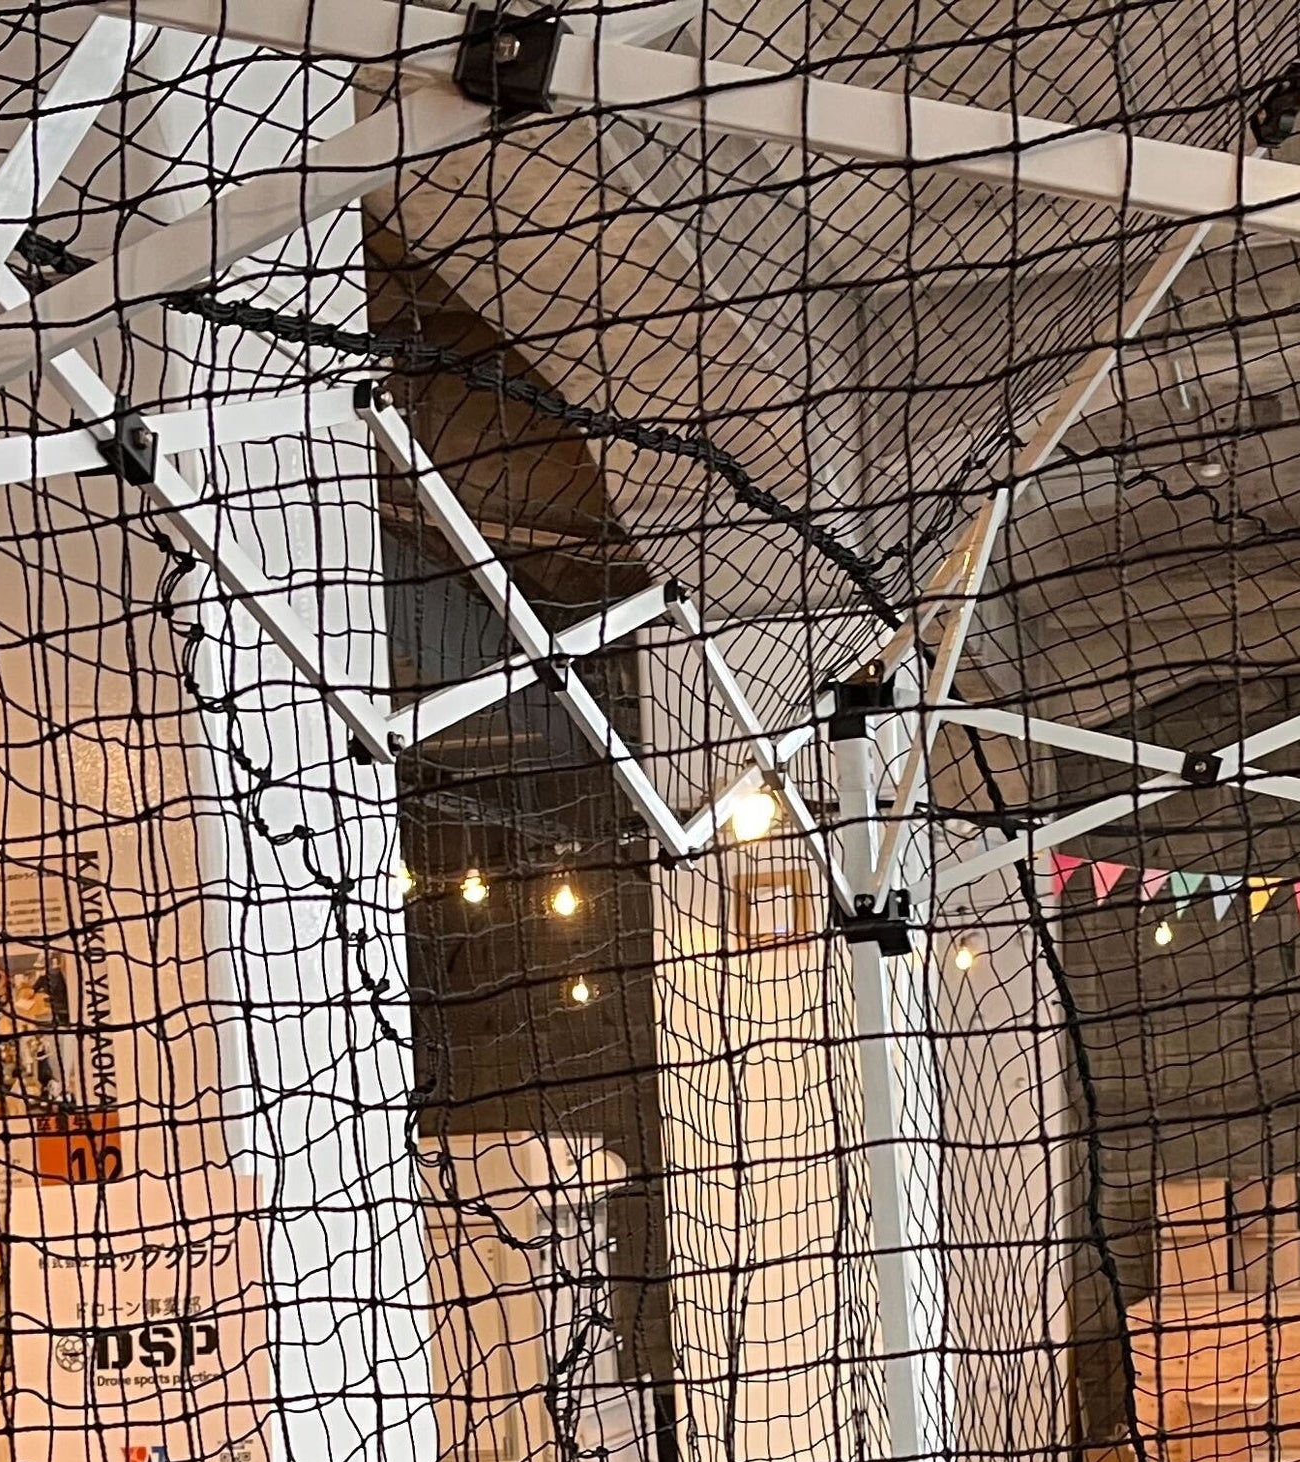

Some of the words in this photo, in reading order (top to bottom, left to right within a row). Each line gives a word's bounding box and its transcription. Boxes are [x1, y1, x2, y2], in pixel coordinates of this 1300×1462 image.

[77, 850, 108, 964] KAYOKO
[85, 973, 119, 1106] YAMAOKA
[97, 1324, 218, 1370] DSP
